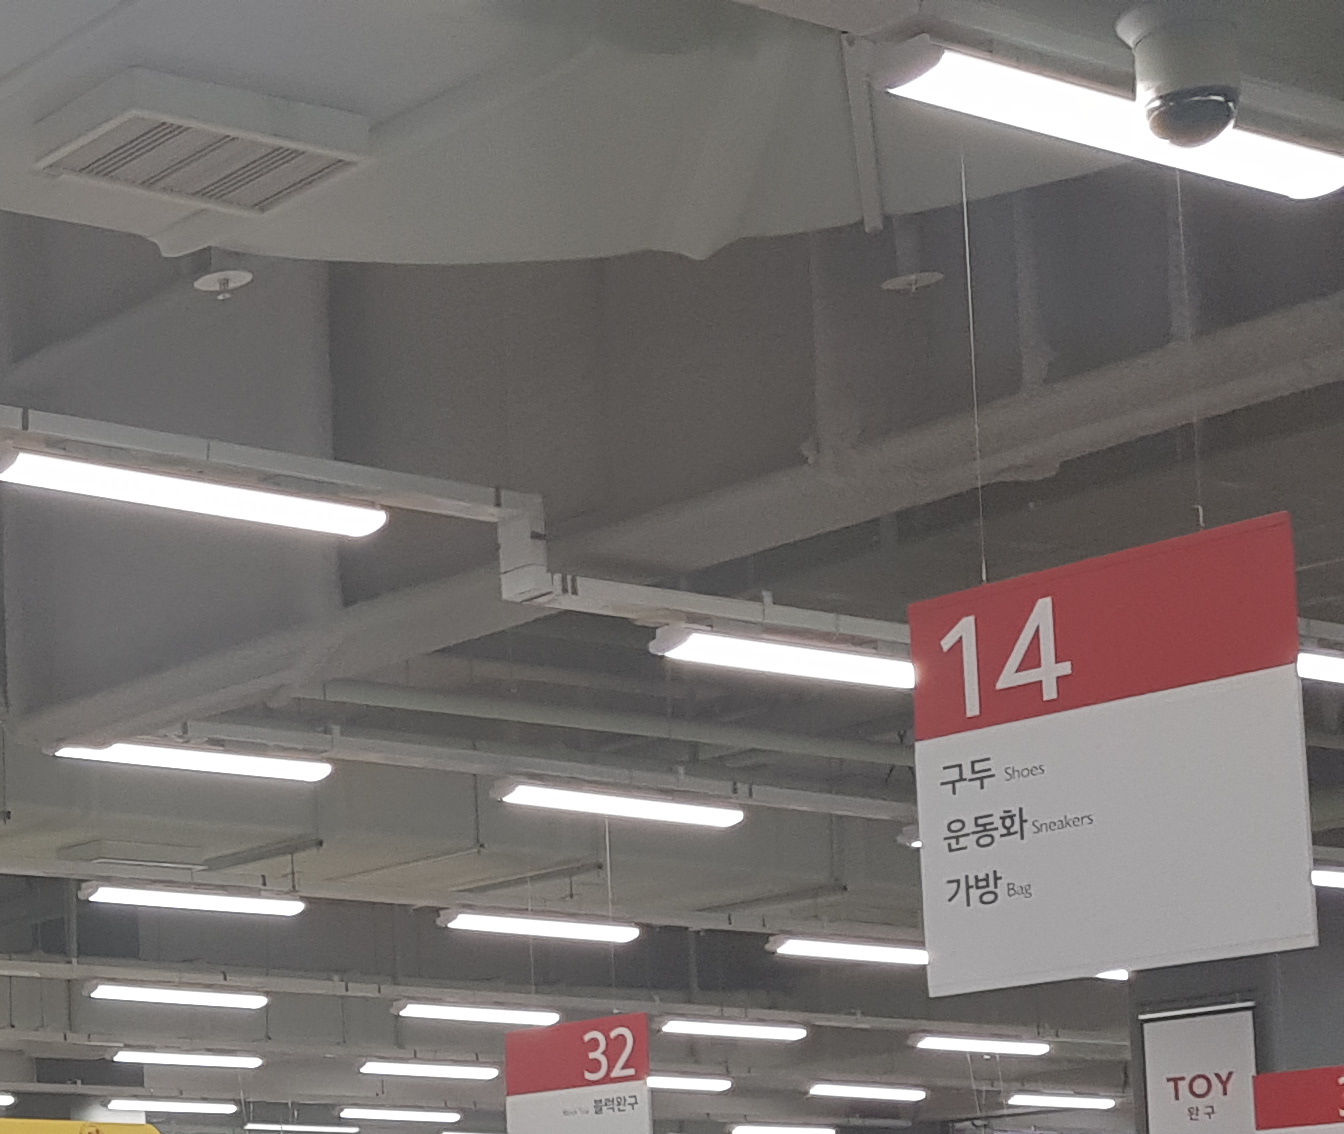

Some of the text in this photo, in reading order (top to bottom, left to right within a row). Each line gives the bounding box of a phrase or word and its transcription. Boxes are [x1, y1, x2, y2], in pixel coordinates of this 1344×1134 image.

[939, 596, 1072, 718] 14
[939, 757, 1045, 795] 구두 Shoes
[943, 807, 1094, 853] 운동화 Sneakers
[946, 869, 1032, 907] 가방 Bag
[583, 1026, 636, 1081] 32
[1166, 1071, 1233, 1101] TOY
[1187, 1105, 1216, 1121] 완구
